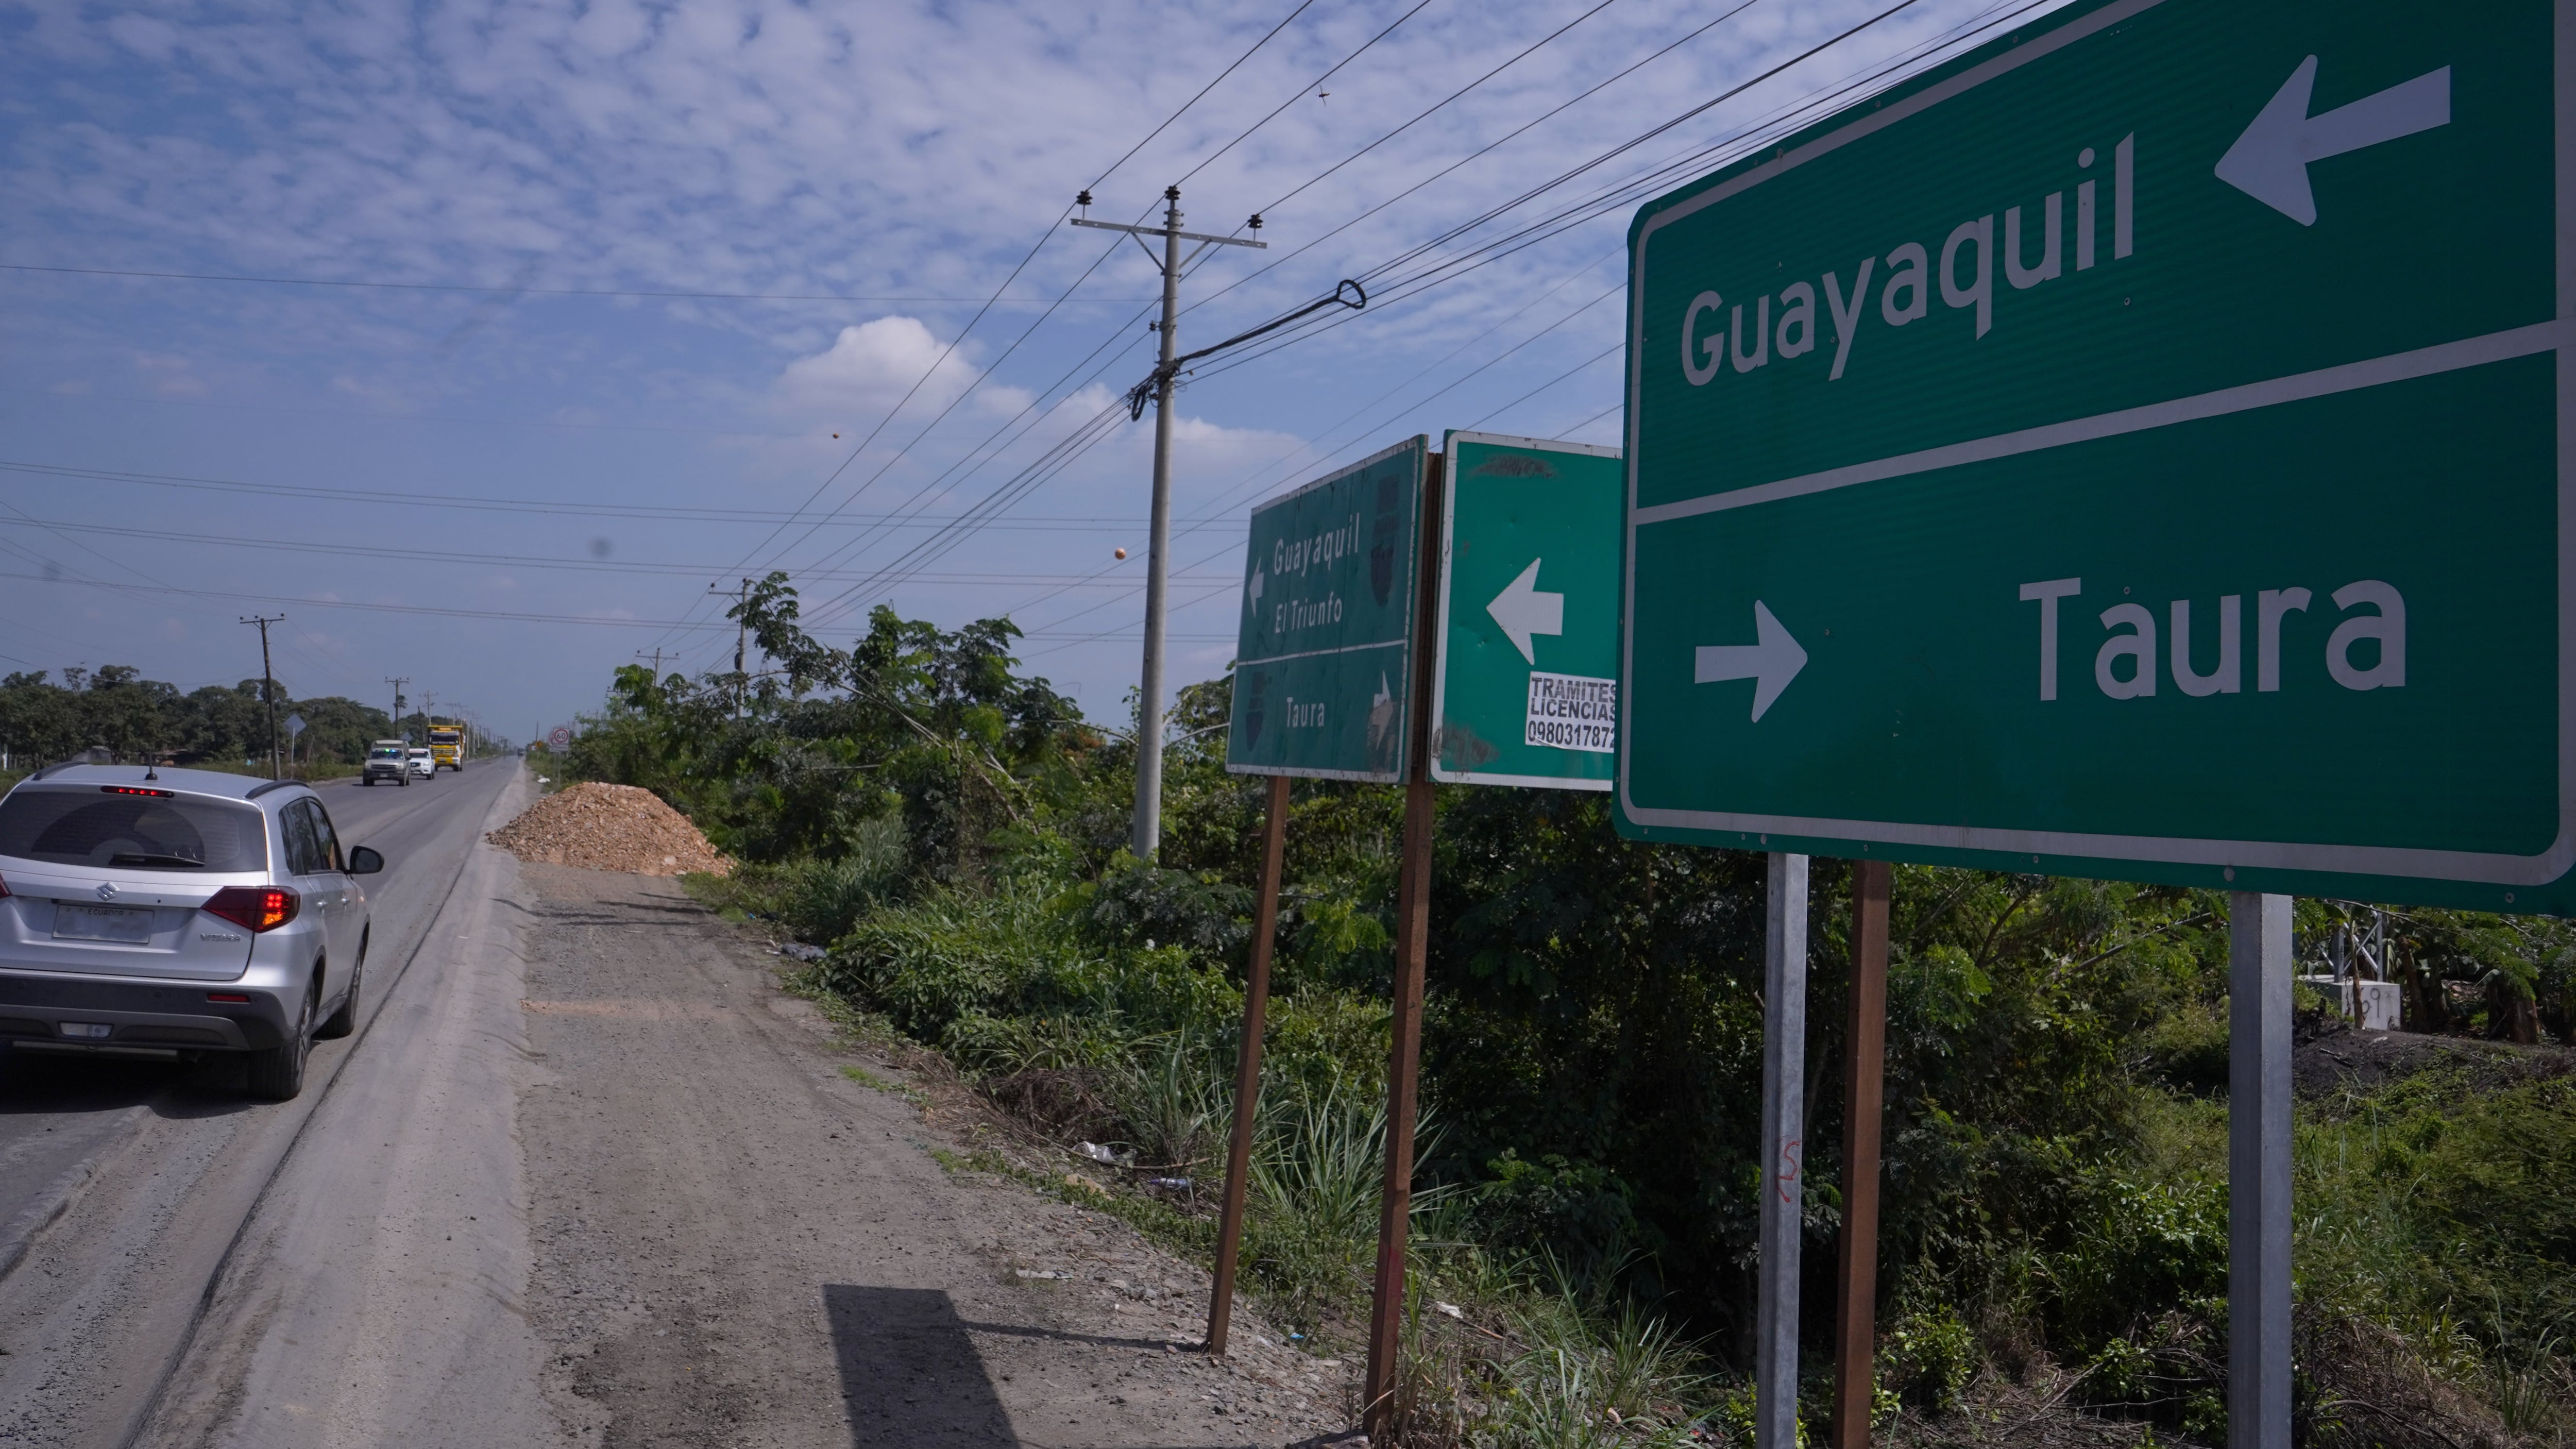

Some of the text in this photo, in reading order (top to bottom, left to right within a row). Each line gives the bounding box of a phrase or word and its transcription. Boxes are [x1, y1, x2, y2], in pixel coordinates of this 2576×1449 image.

[1681, 131, 2134, 386] Guayaquil
[1274, 512, 1360, 577] Guayaquil
[1275, 591, 1342, 633] El Triunfo
[2019, 577, 2406, 701] Taura
[1531, 677, 1616, 703] TRAMITES
[1286, 697, 1325, 728] Taura
[1531, 698, 1615, 722] LICENCIAS
[1528, 720, 1615, 748] 0980317872
[88, 908, 124, 916] ECUADOR
